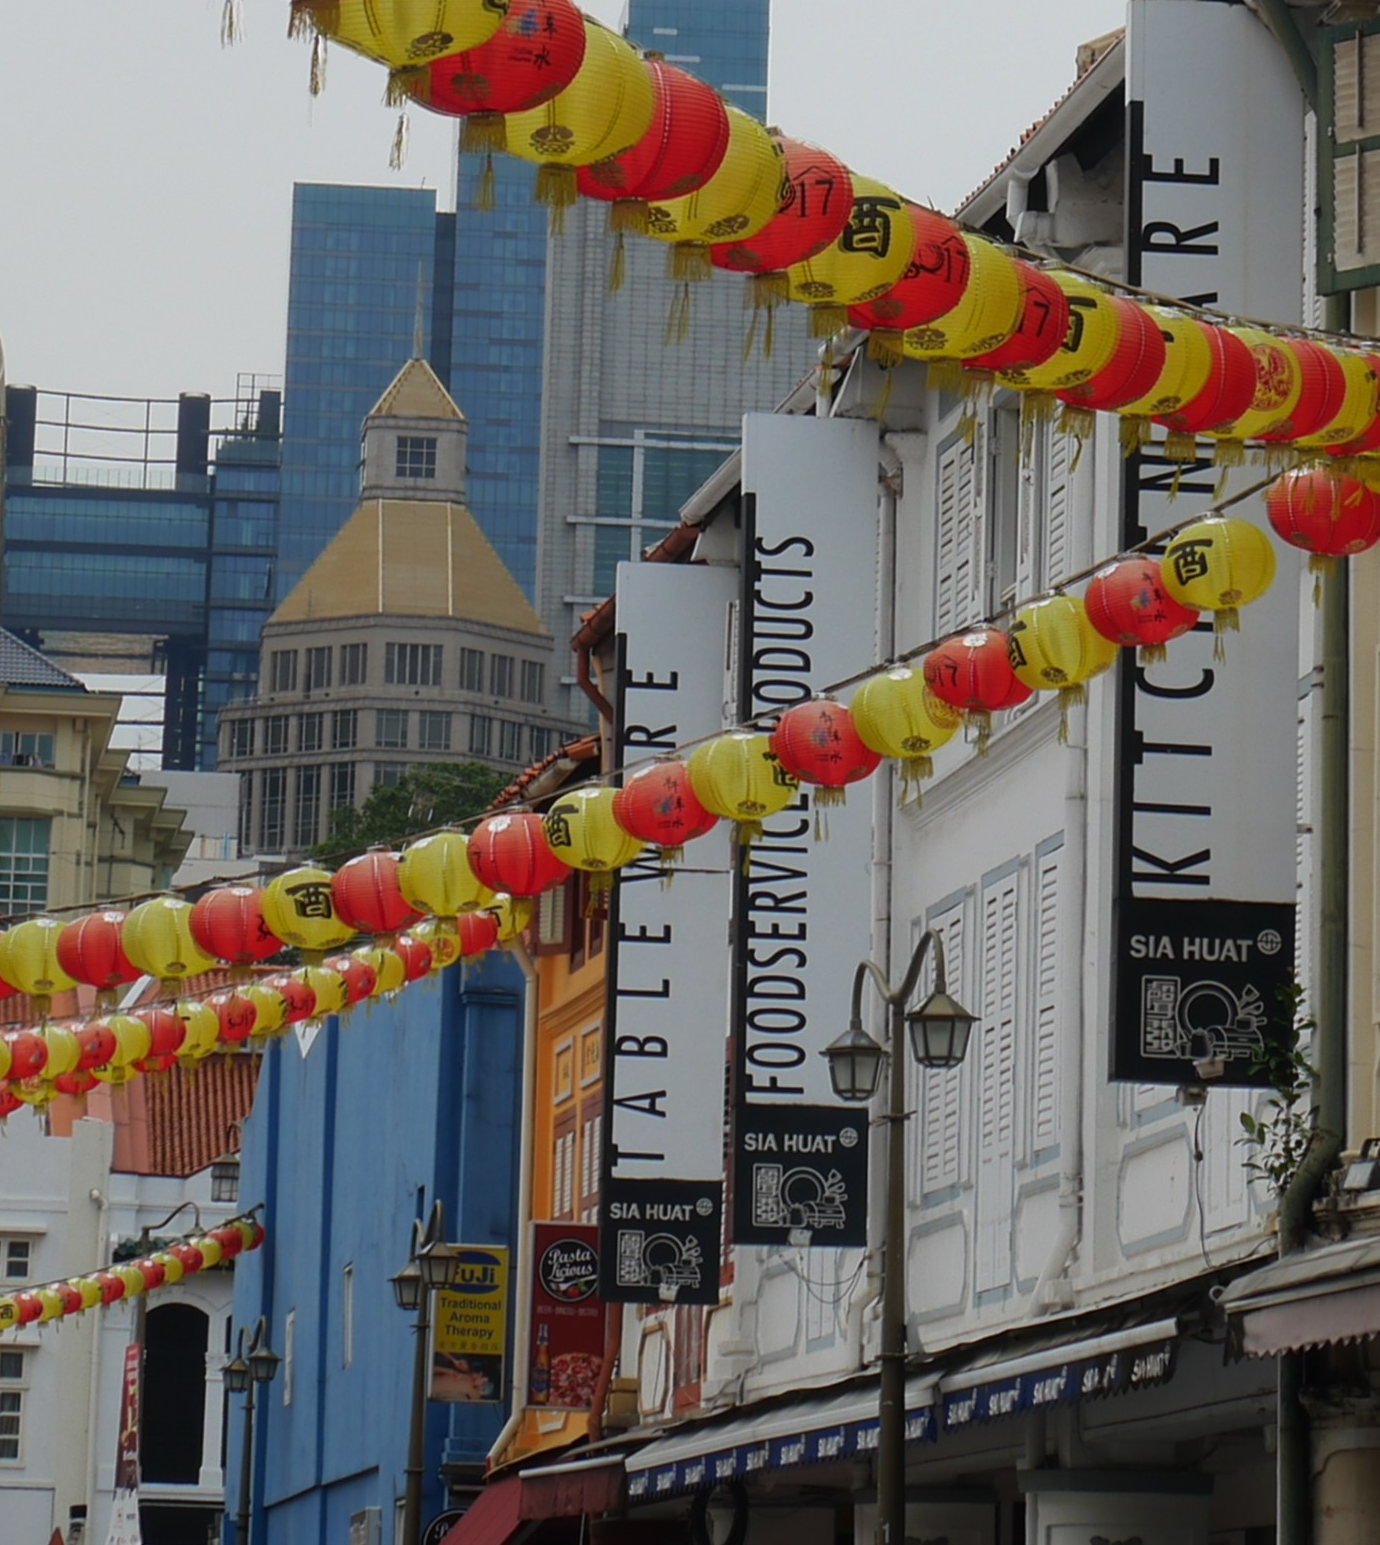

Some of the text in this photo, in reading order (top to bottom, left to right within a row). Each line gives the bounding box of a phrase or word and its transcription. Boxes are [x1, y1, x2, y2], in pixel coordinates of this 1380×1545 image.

[1128, 933, 1254, 963] SIA HUAT
[743, 1132, 837, 1154] SIA HUAT
[608, 1202, 694, 1222] SIA HUAT
[547, 1248, 592, 1266] Pasta
[546, 1263, 594, 1283] Licious
[440, 1297, 502, 1311] Traditional
[449, 1312, 490, 1324] Aroma
[445, 1324, 494, 1340] Therapy
